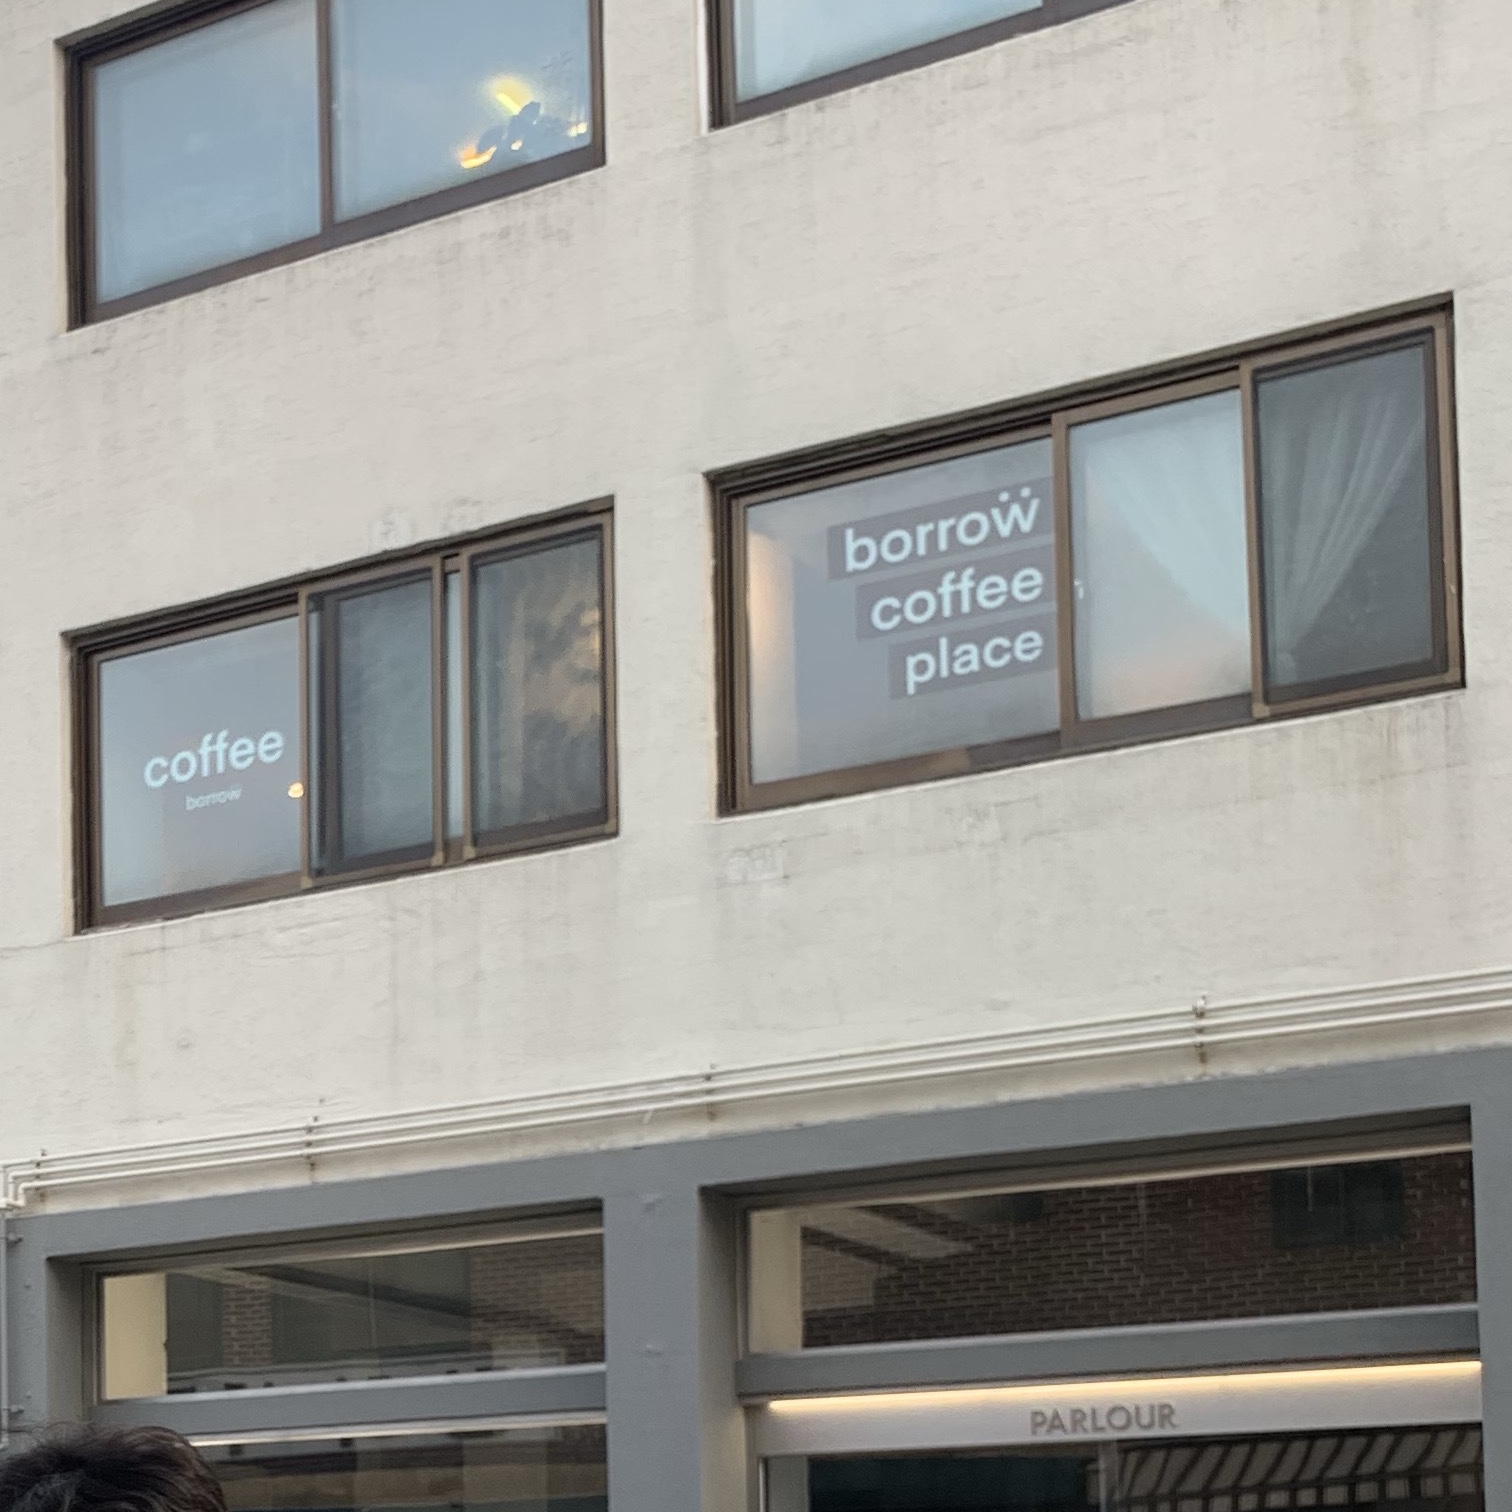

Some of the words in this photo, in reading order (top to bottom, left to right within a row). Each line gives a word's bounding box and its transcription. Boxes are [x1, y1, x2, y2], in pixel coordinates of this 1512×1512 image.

[870, 566, 1044, 631] coffee
[904, 630, 1044, 696] place
[143, 728, 286, 789] coffee
[1029, 1403, 1179, 1436] PARLOUR
